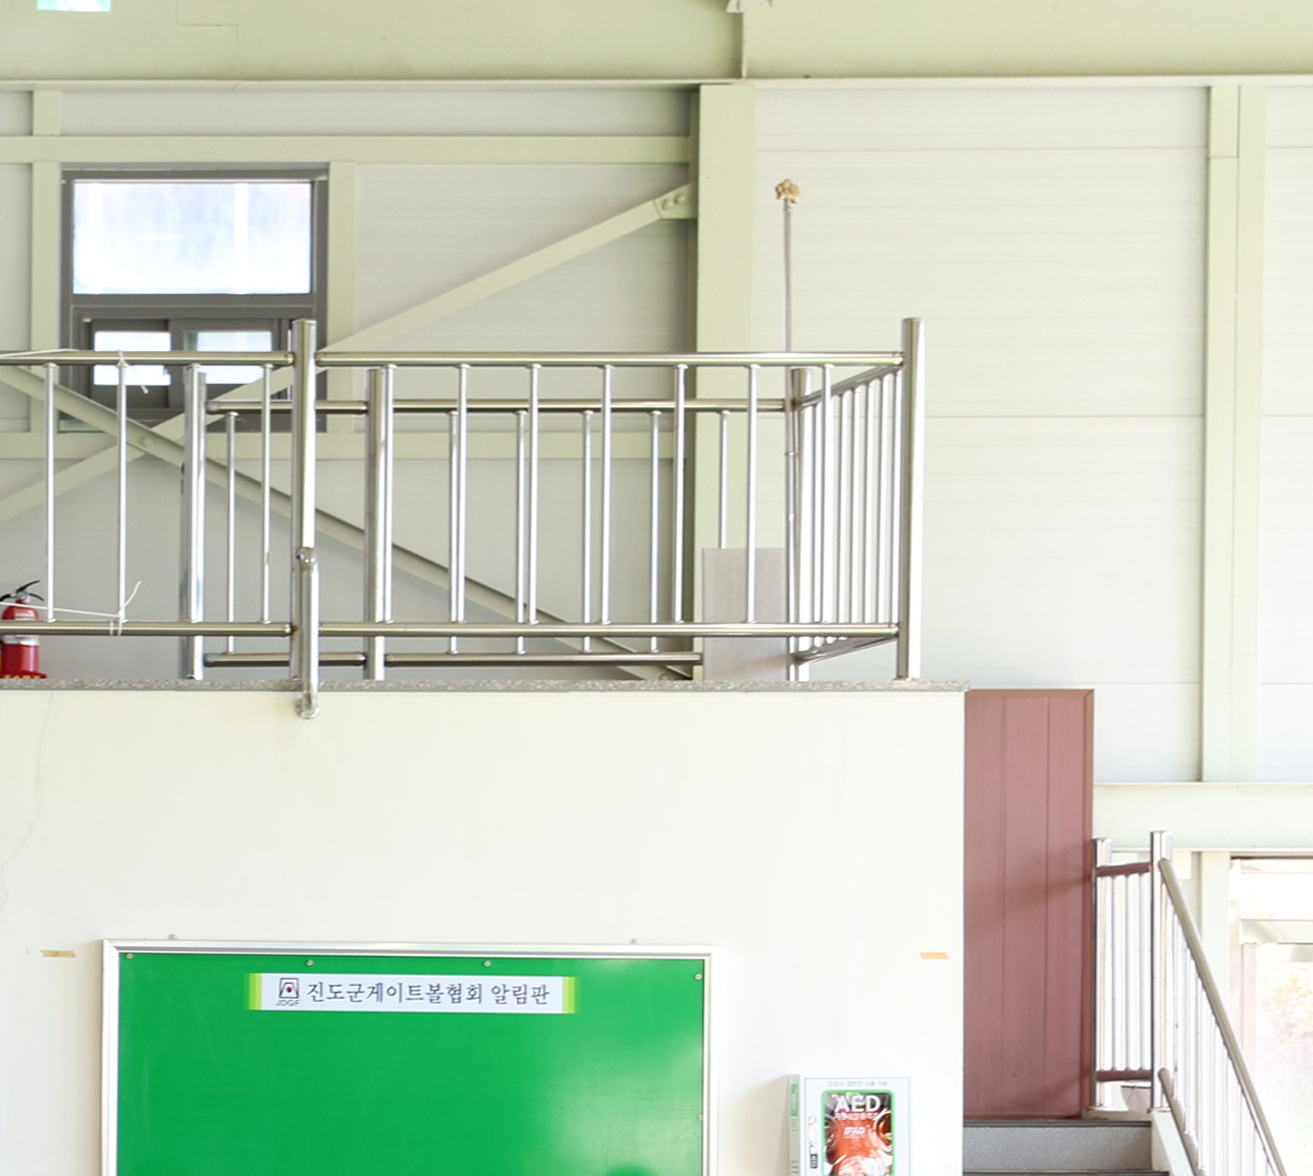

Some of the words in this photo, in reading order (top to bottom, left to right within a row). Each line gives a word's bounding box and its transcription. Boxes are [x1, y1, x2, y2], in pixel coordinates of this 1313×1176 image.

[306, 981, 483, 1005] 진도군게이트볼협회
[490, 983, 550, 1006] 알림판
[834, 1094, 882, 1113] AED
